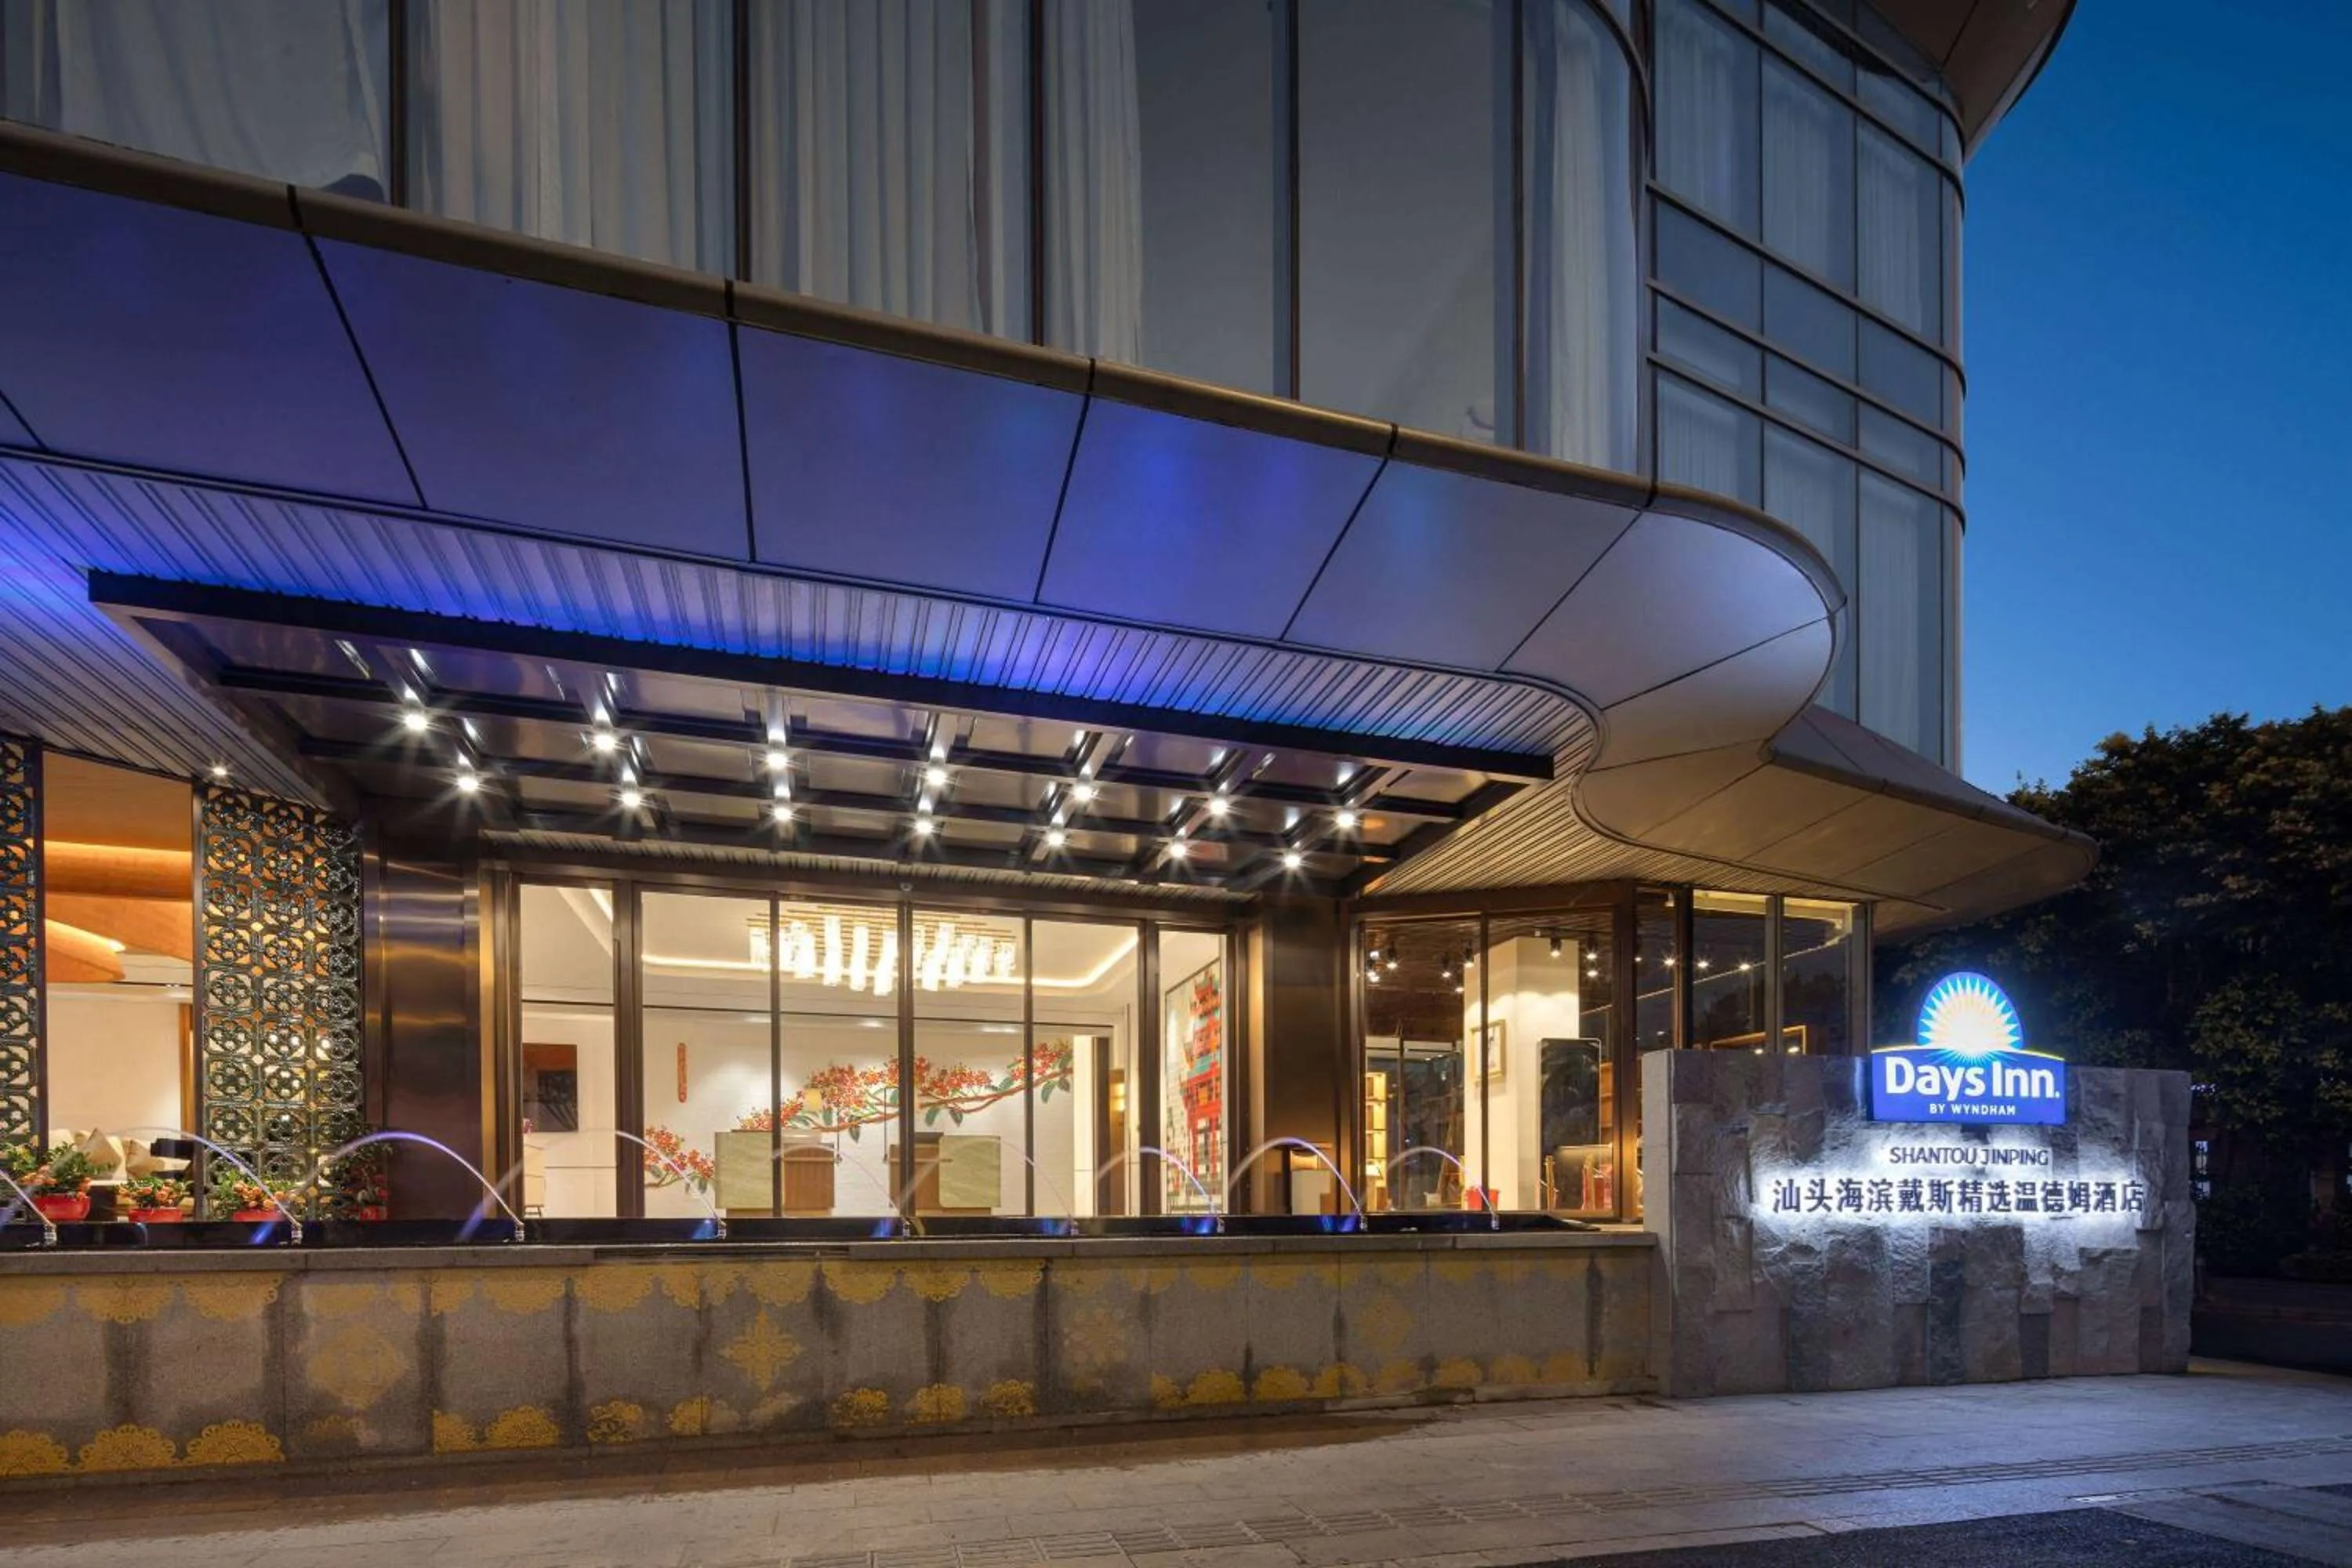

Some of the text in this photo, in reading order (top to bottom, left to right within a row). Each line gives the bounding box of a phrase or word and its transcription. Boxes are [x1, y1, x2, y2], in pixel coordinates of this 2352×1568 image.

[1886, 1056, 1986, 1101] Days
[1929, 1103, 2016, 1116] BY WYNDHAM
[1889, 1147, 2049, 1166] SHANTOU JINPING
[1773, 1178, 2143, 1213] 汕头海滨戴斯精选温德姆酒店
